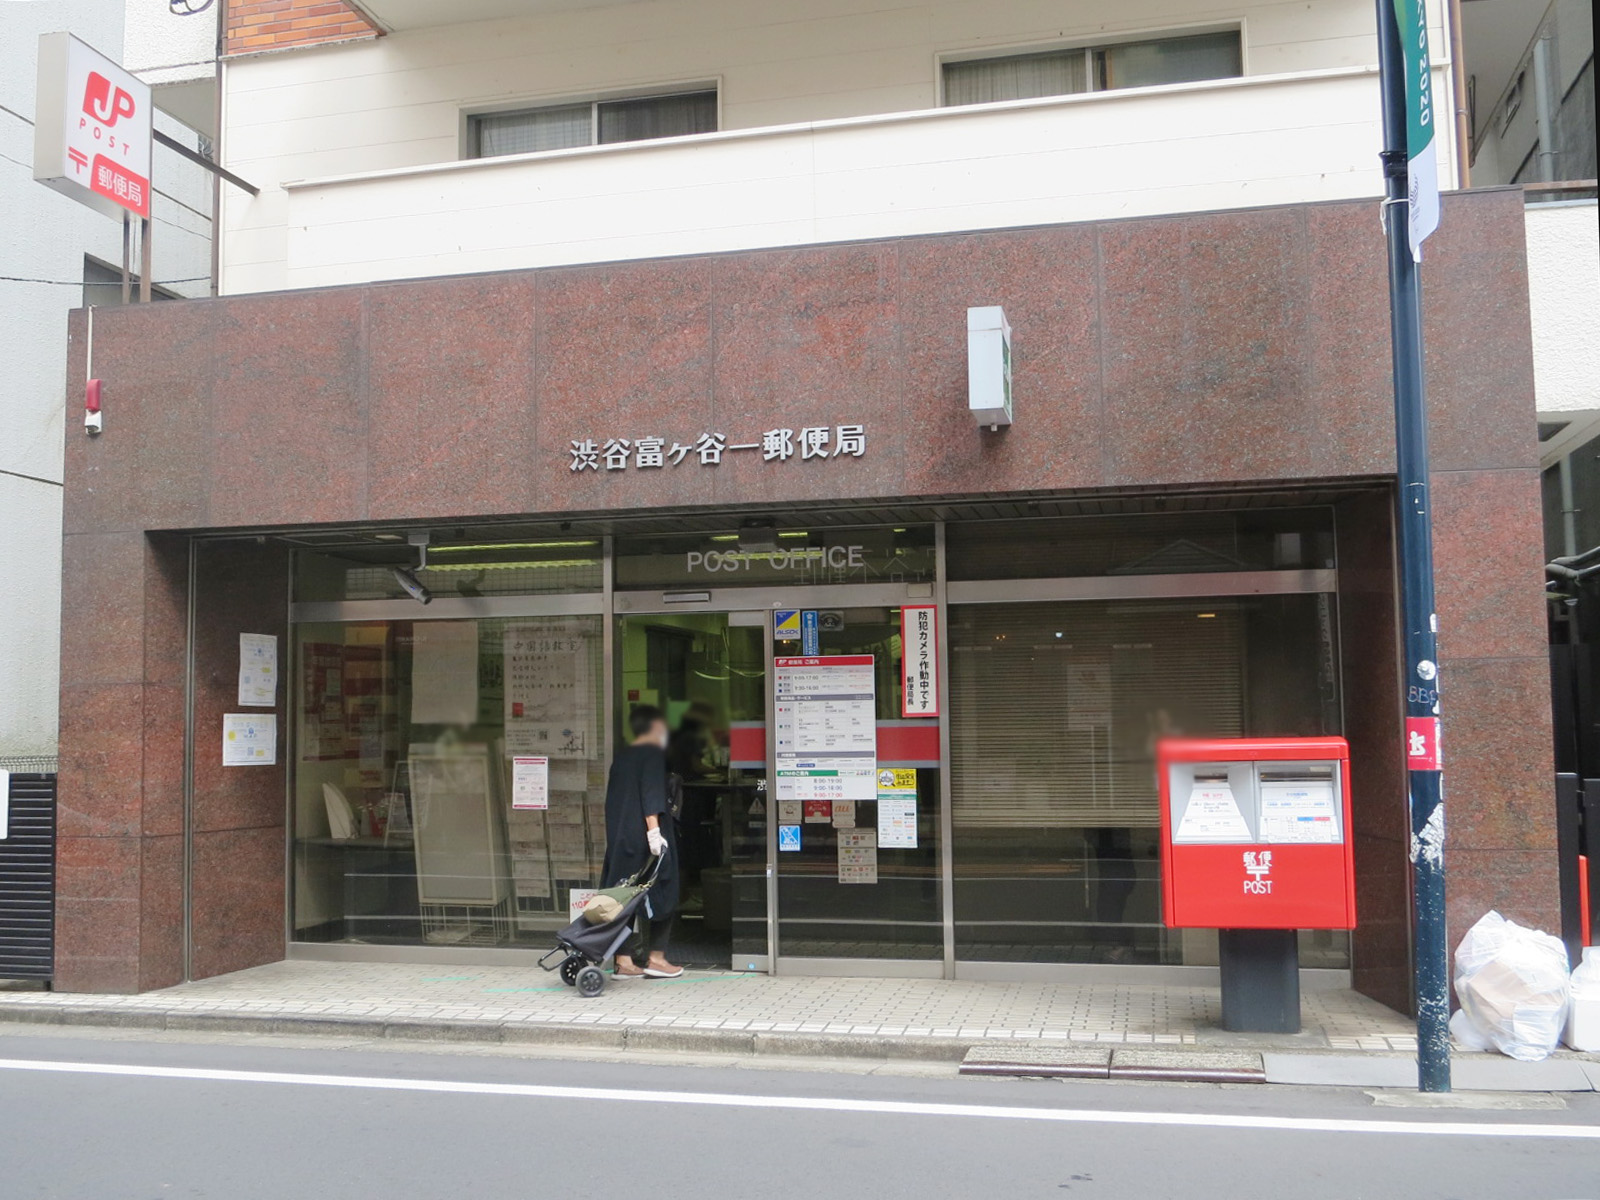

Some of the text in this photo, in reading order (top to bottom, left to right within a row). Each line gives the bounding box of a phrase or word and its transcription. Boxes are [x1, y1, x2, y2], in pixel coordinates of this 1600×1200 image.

[1419, 54, 1430, 127] 2020
[79, 117, 130, 156] POST
[98, 165, 142, 207] 郵便局
[687, 545, 864, 573] POST OFFICE
[918, 611, 930, 710] 防犯カメラ作動中です
[1243, 850, 1273, 867] 郵便
[1243, 880, 1273, 894] POST
